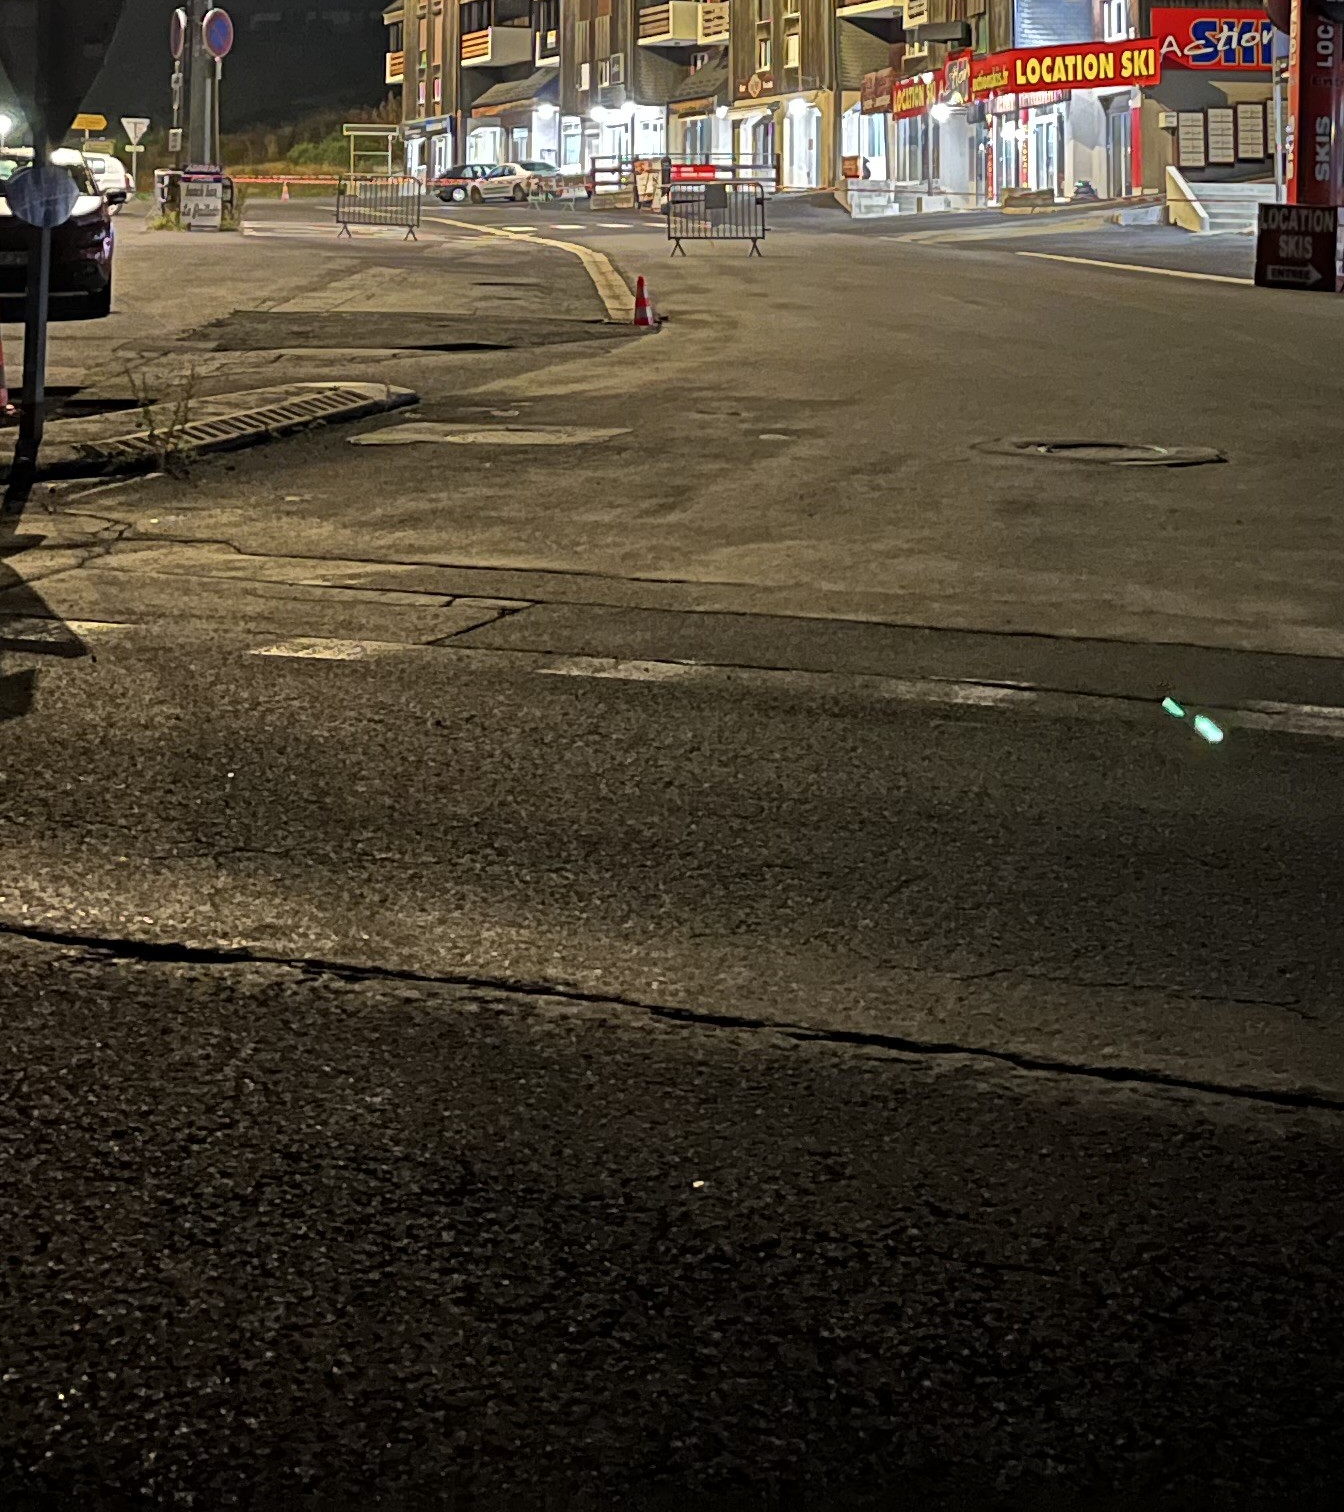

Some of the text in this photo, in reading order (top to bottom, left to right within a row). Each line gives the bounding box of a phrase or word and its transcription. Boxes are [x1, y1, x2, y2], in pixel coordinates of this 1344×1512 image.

[1015, 48, 1156, 85] LOCATION SKI
[1314, 115, 1331, 182] SKIS
[1259, 206, 1335, 233] LOCATION
[1278, 234, 1313, 260] SKIS
